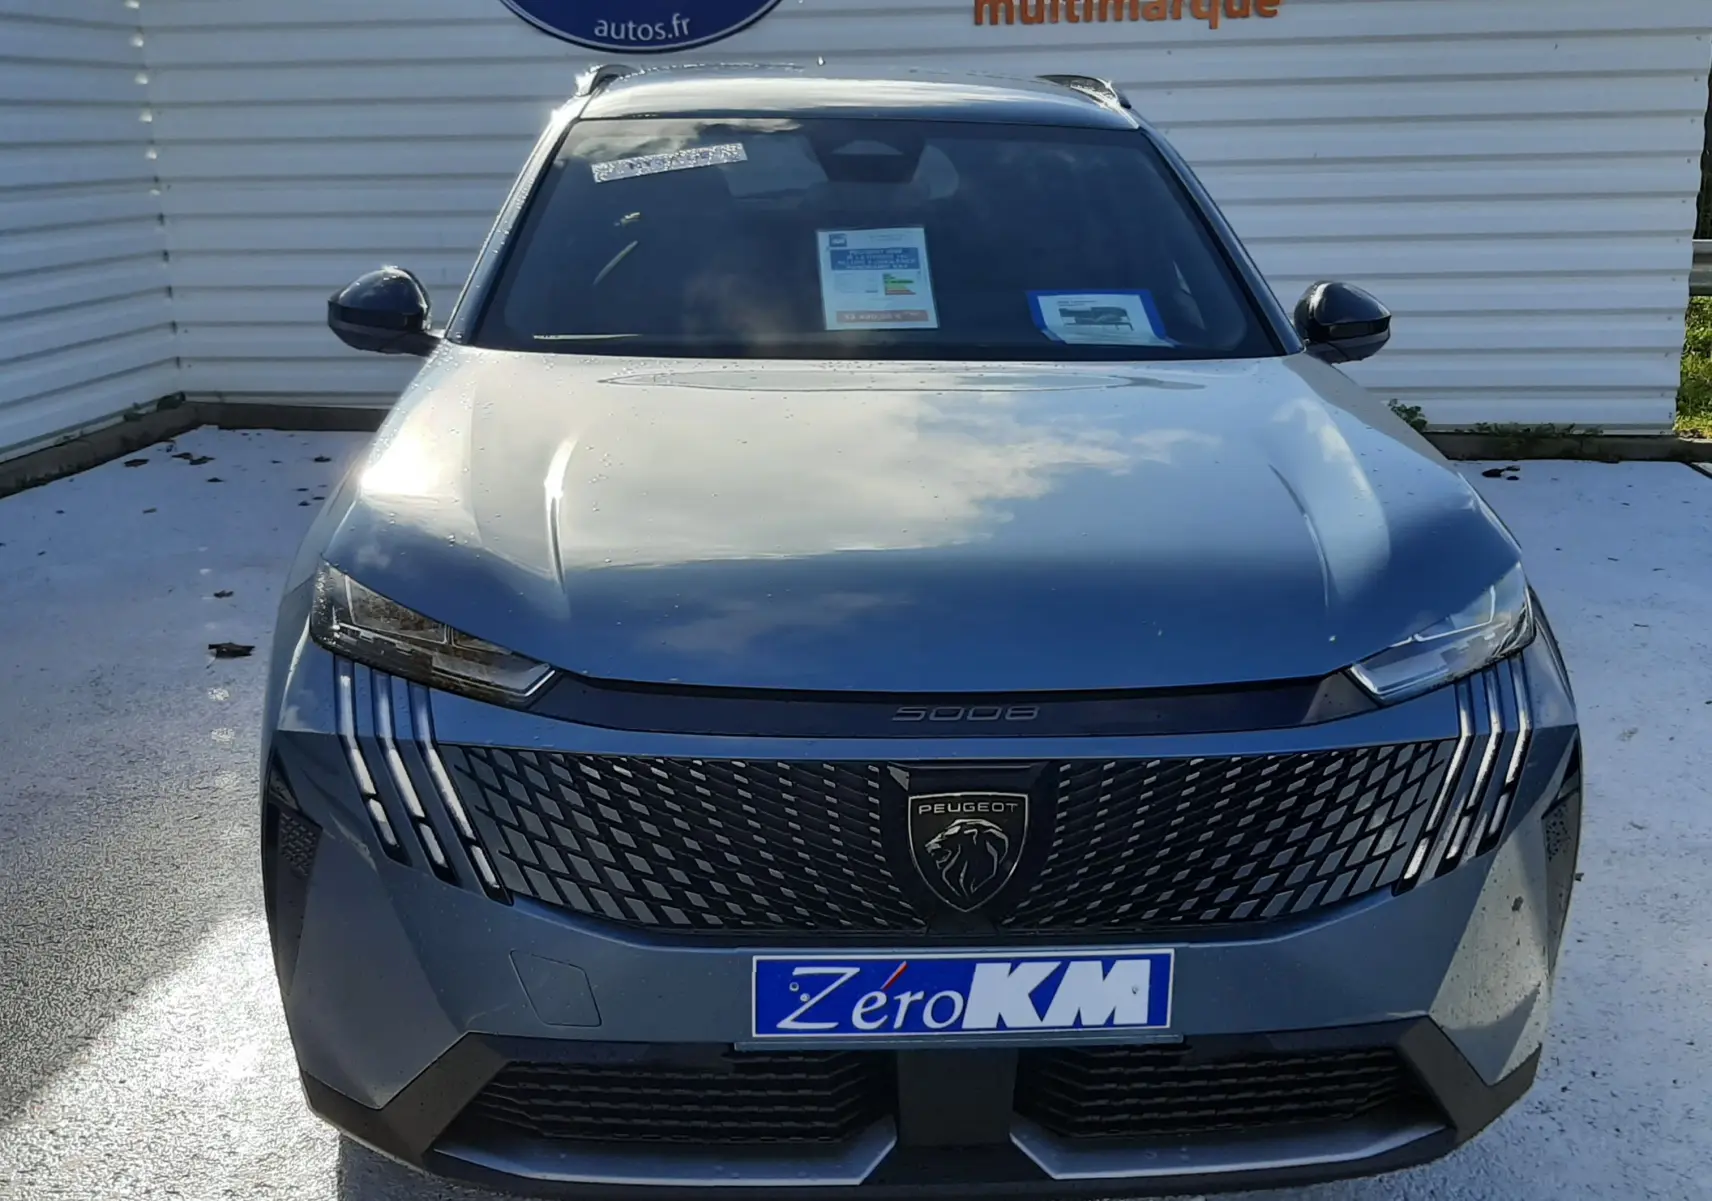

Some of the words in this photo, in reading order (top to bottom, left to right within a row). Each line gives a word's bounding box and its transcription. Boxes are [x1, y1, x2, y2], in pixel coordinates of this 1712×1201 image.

[974, 0, 1280, 29] multimarque
[594, 13, 690, 41] autos.fr
[892, 706, 1040, 721] 5008
[918, 802, 1018, 815] PEUGEOT
